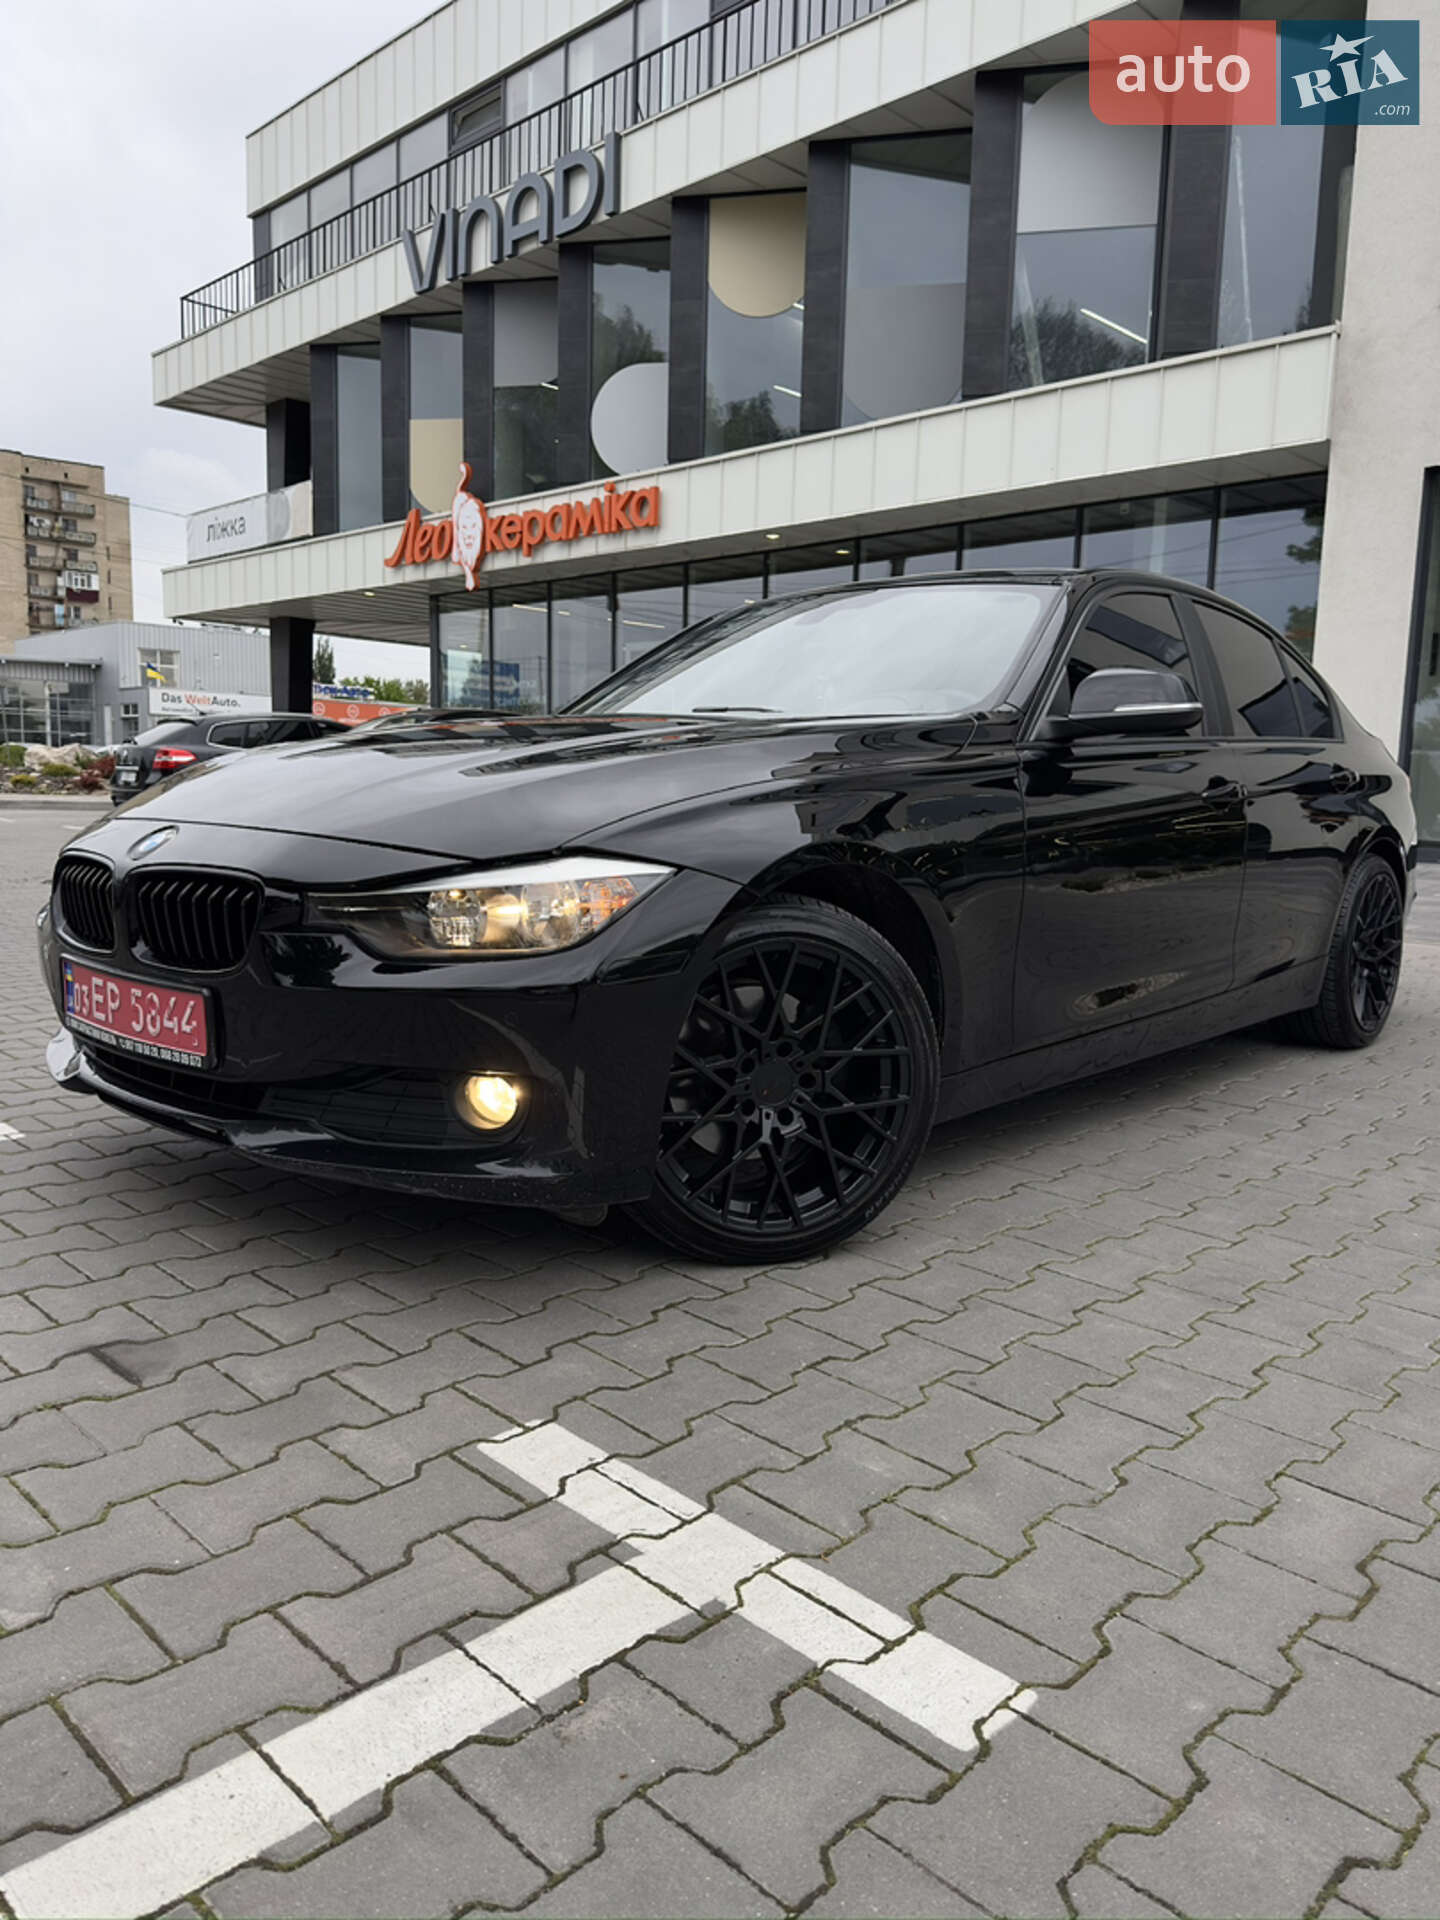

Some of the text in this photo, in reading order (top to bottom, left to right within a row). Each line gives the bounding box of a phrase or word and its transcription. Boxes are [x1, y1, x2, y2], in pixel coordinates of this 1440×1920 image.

[402, 131, 623, 295] VINADI
[206, 516, 247, 543] ліжка
[161, 692, 182, 704] Das
[130, 987, 198, 1037] 5844
